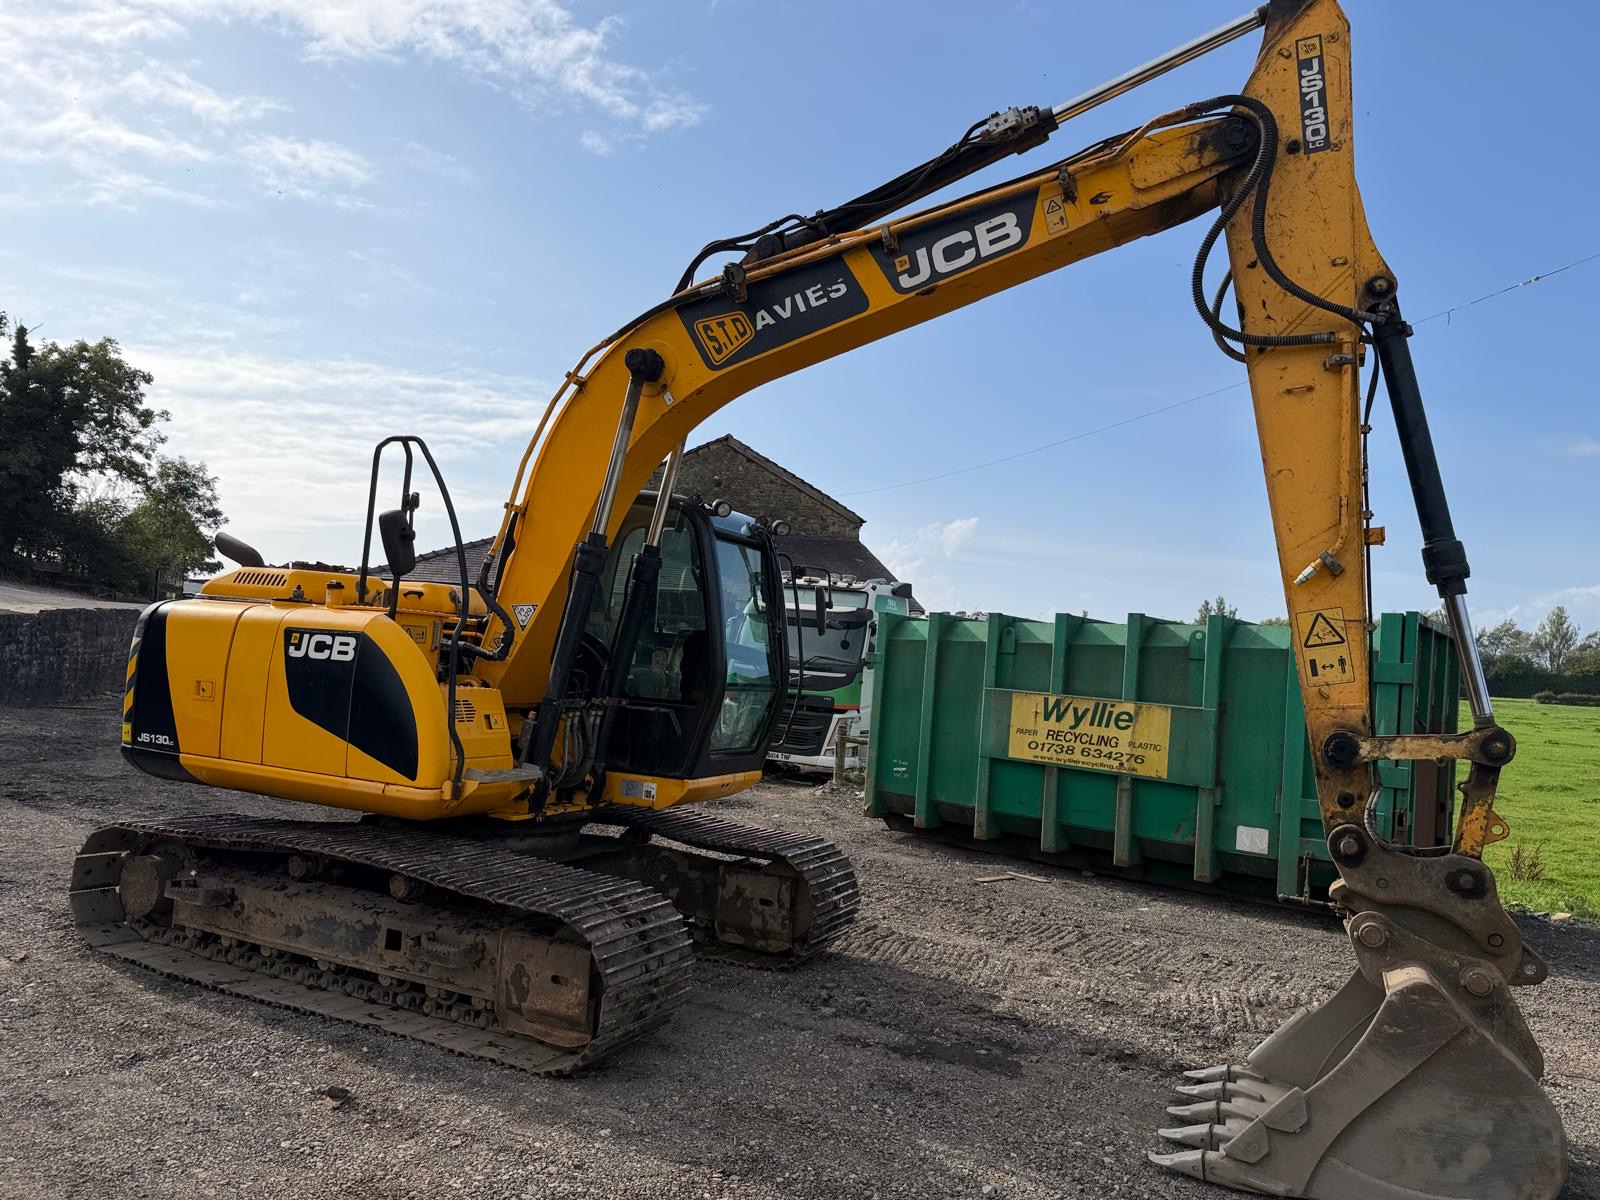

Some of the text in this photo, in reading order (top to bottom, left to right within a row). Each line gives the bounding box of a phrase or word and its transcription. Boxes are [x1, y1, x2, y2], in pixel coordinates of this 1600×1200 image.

[1301, 58, 1326, 142] JS130
[898, 212, 1022, 289] JCB
[756, 278, 848, 331] AVIES
[288, 633, 357, 662] JCB
[1043, 696, 1134, 731] Wyllie
[137, 732, 169, 745] JS130
[1015, 727, 1162, 753] PAPER RECYCLING PLASTIC
[1027, 740, 1145, 765] 01738 634276
